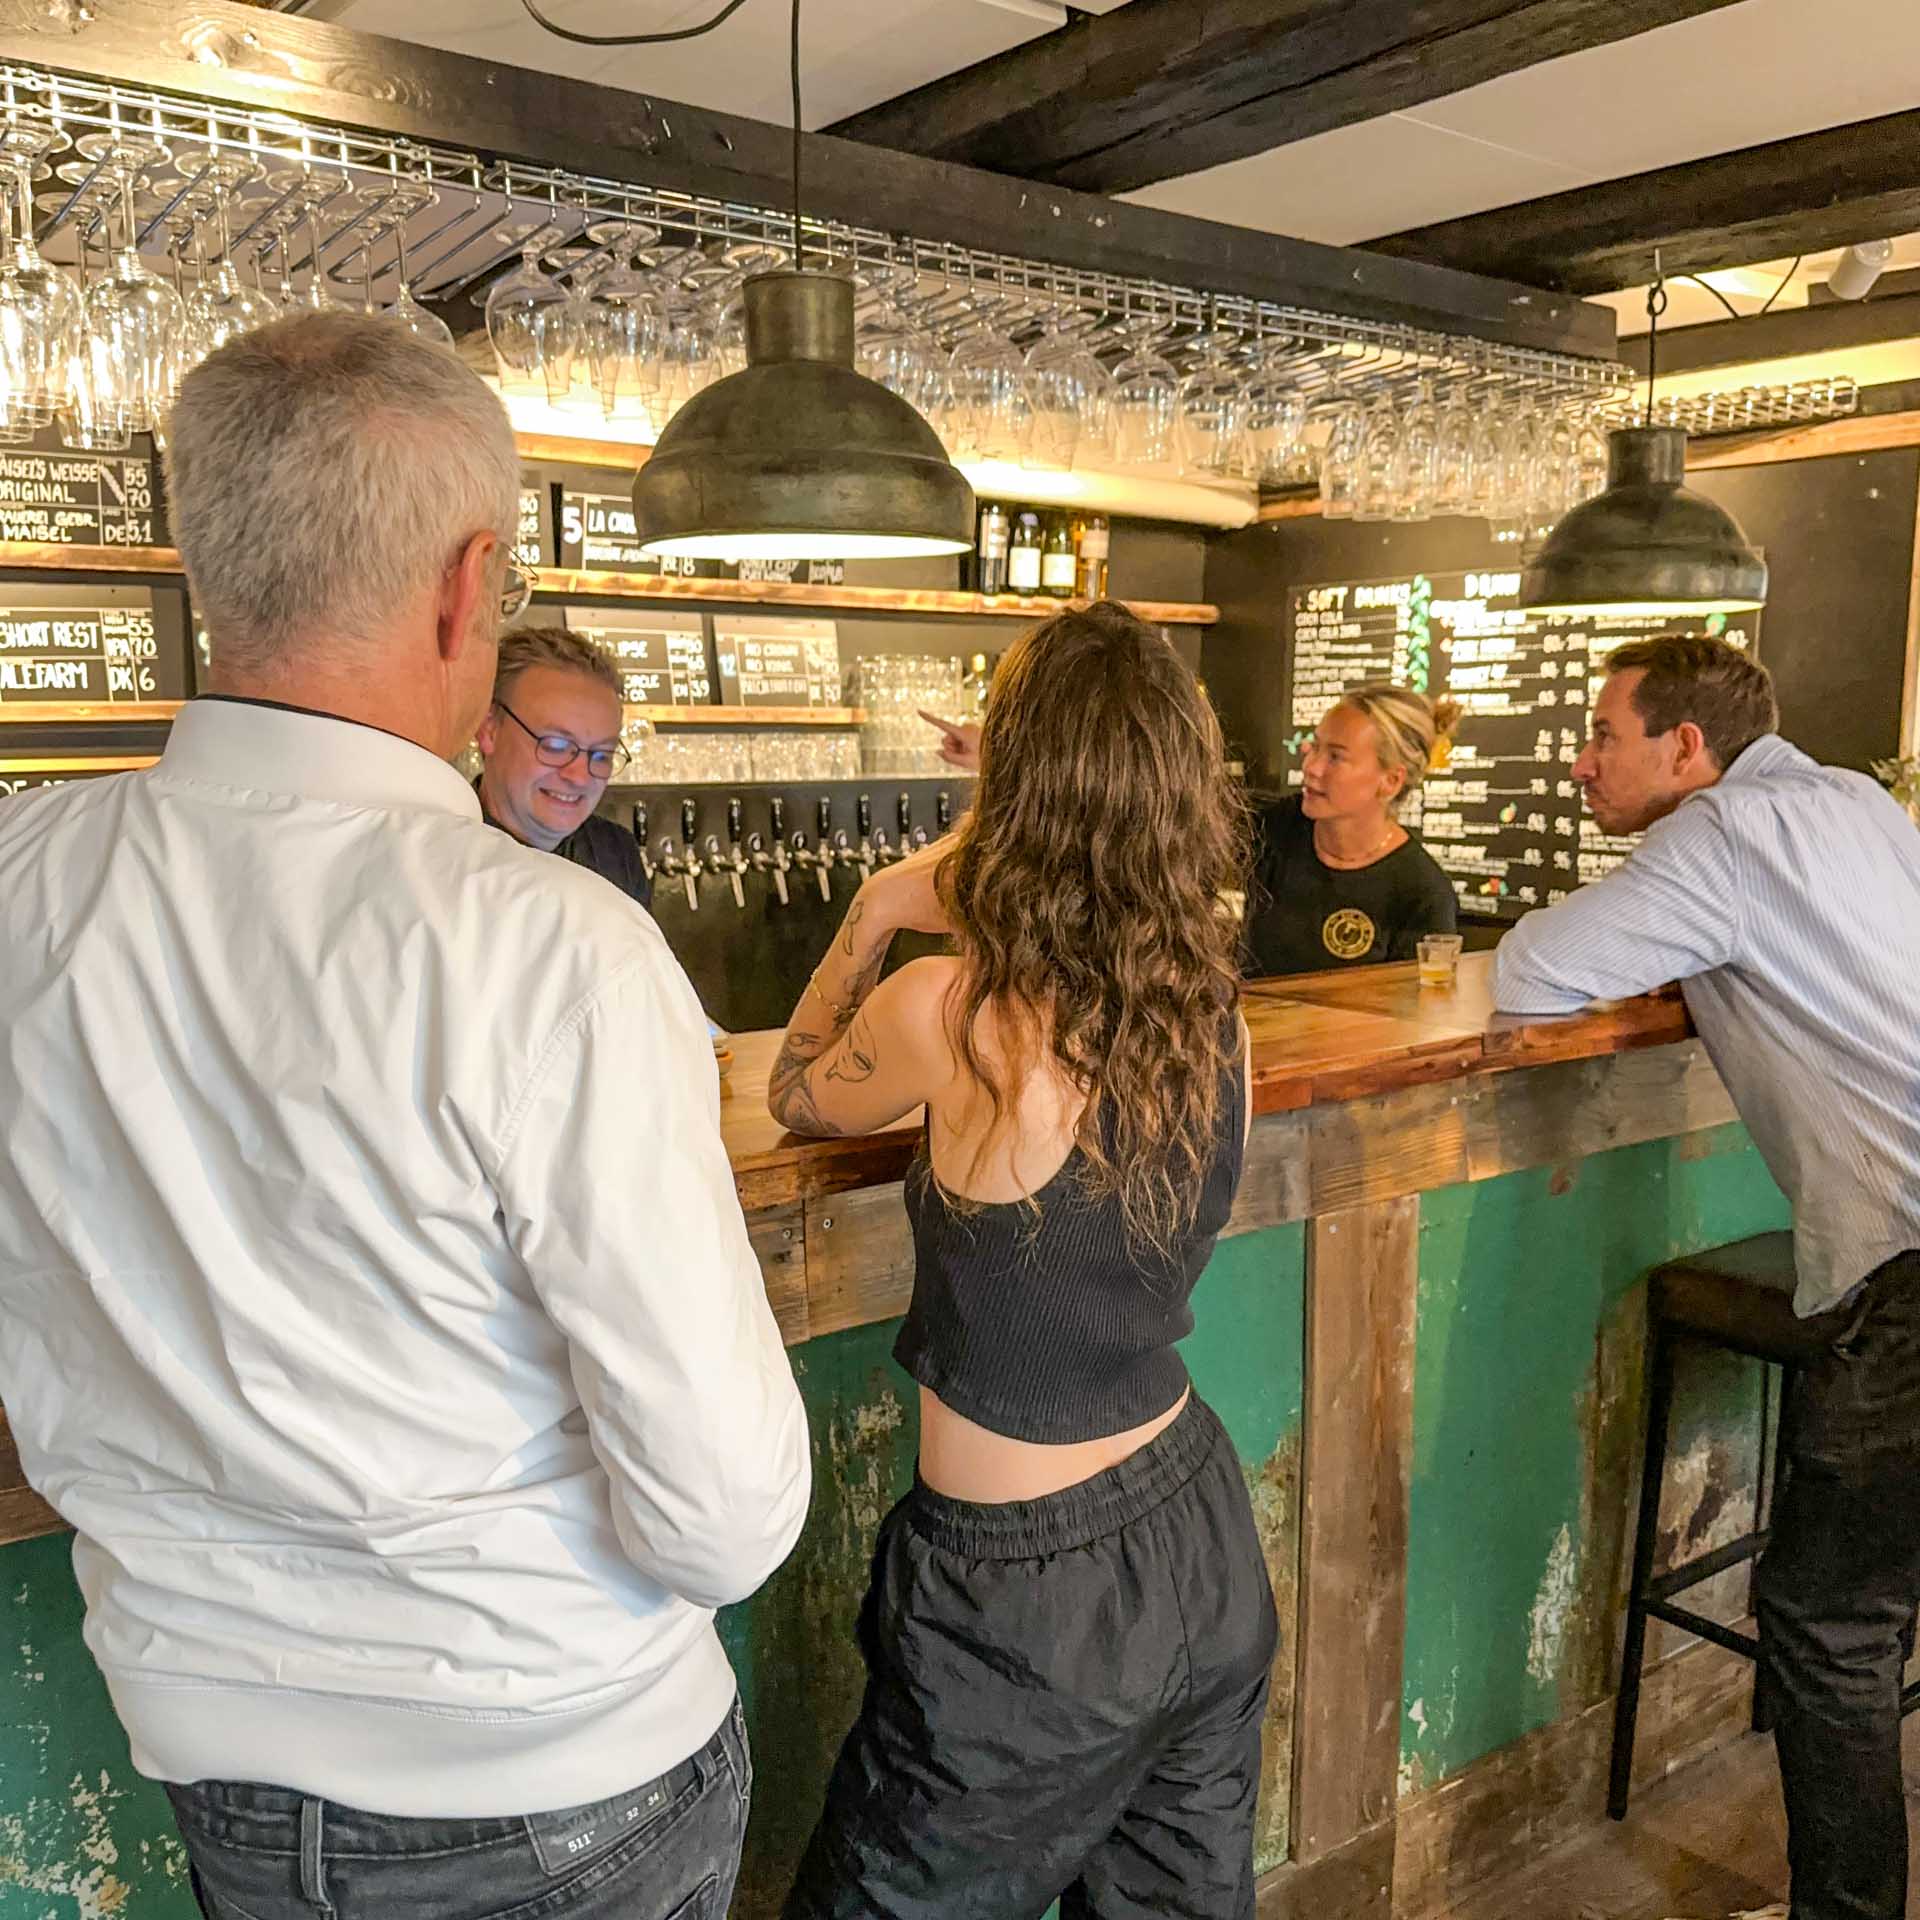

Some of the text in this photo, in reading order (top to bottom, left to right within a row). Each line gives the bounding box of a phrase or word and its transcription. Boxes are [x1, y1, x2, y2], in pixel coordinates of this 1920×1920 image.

[0, 458, 98, 482] AISEL'S WEISSE
[126, 467, 148, 488] 55
[128, 488, 151, 508] 70
[3, 523, 73, 542] MAISEL
[105, 524, 127, 542] DE
[563, 507, 582, 543] 5
[1307, 586, 1348, 611] SOFT
[52, 621, 99, 649] REST
[128, 618, 154, 636] 55
[0, 662, 88, 690] ALEFARM
[109, 666, 156, 691] DK 6
